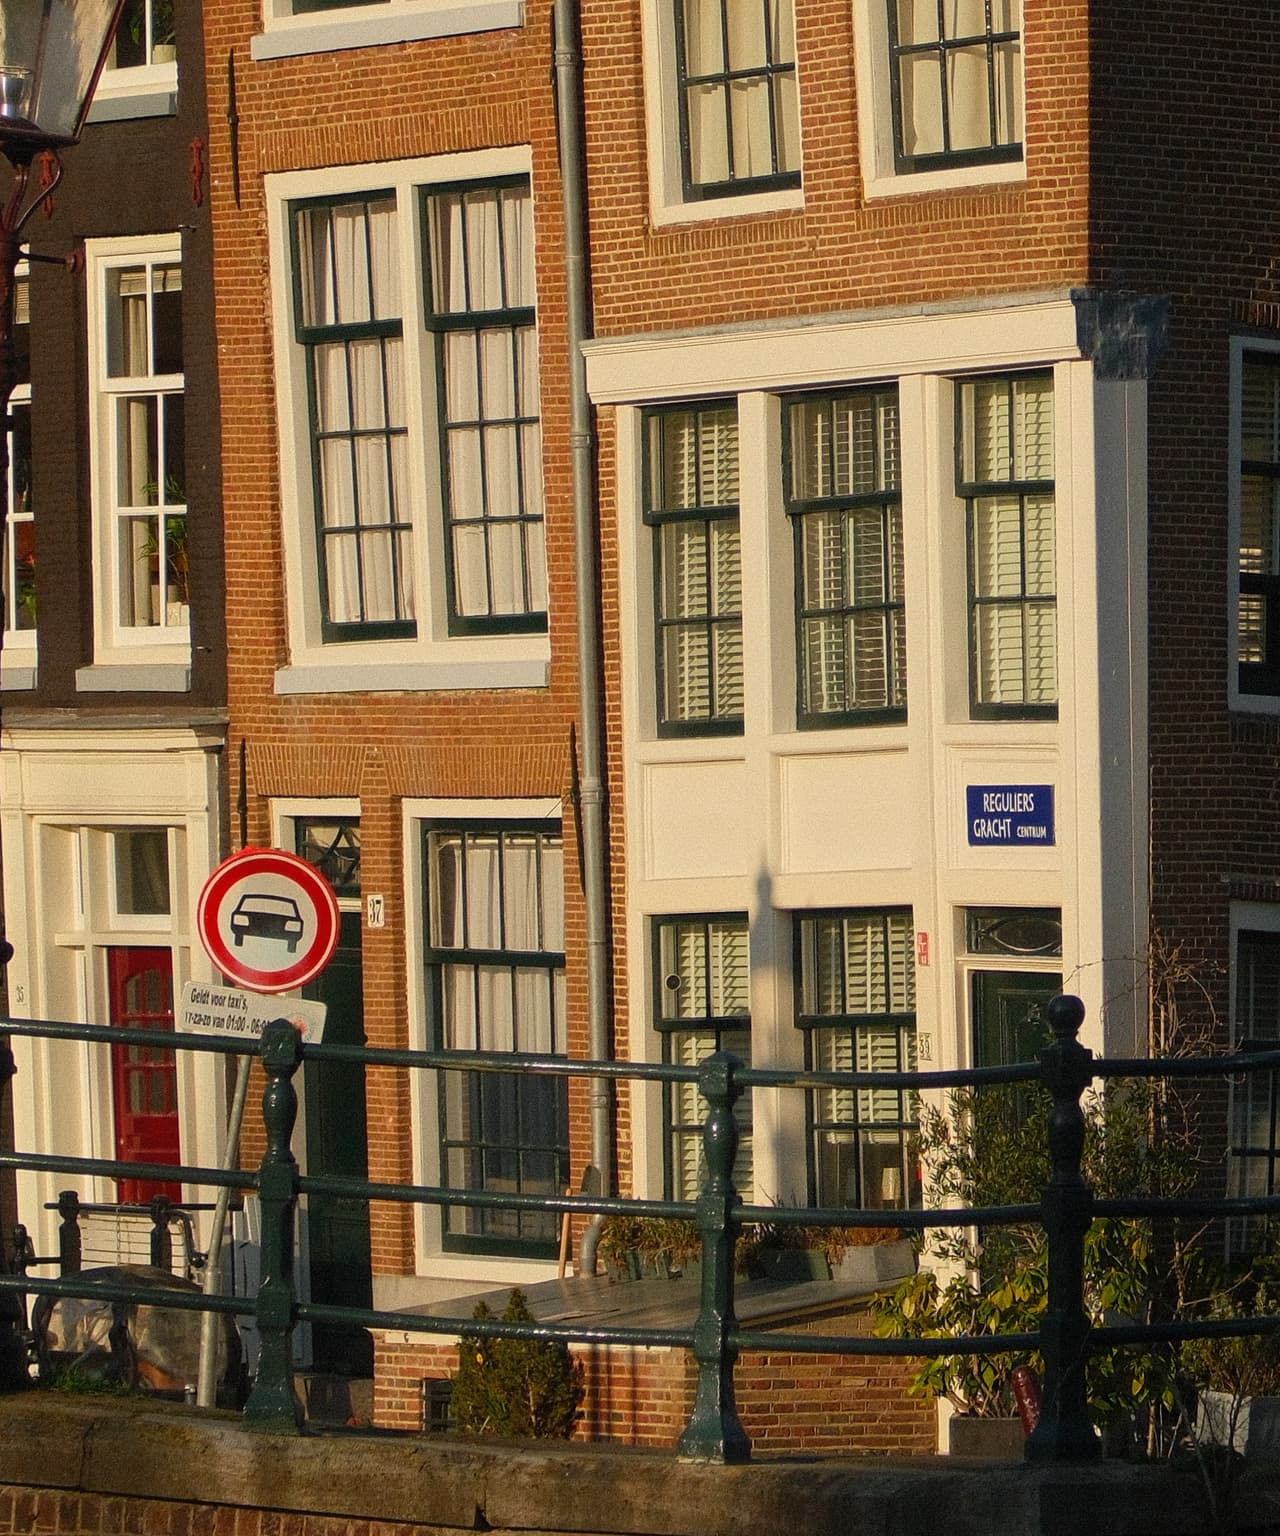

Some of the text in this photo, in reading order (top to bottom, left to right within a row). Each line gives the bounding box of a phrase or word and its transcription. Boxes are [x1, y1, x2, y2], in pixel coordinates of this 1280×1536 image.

[983, 792, 1035, 813] REGULIERS
[973, 818, 1047, 839] GRACHT CENTRUM
[369, 898, 382, 923] 37
[191, 988, 210, 1005] Geldt
[211, 991, 226, 1007] voor
[213, 1015, 225, 1029] van
[226, 1014, 246, 1032] 01:00
